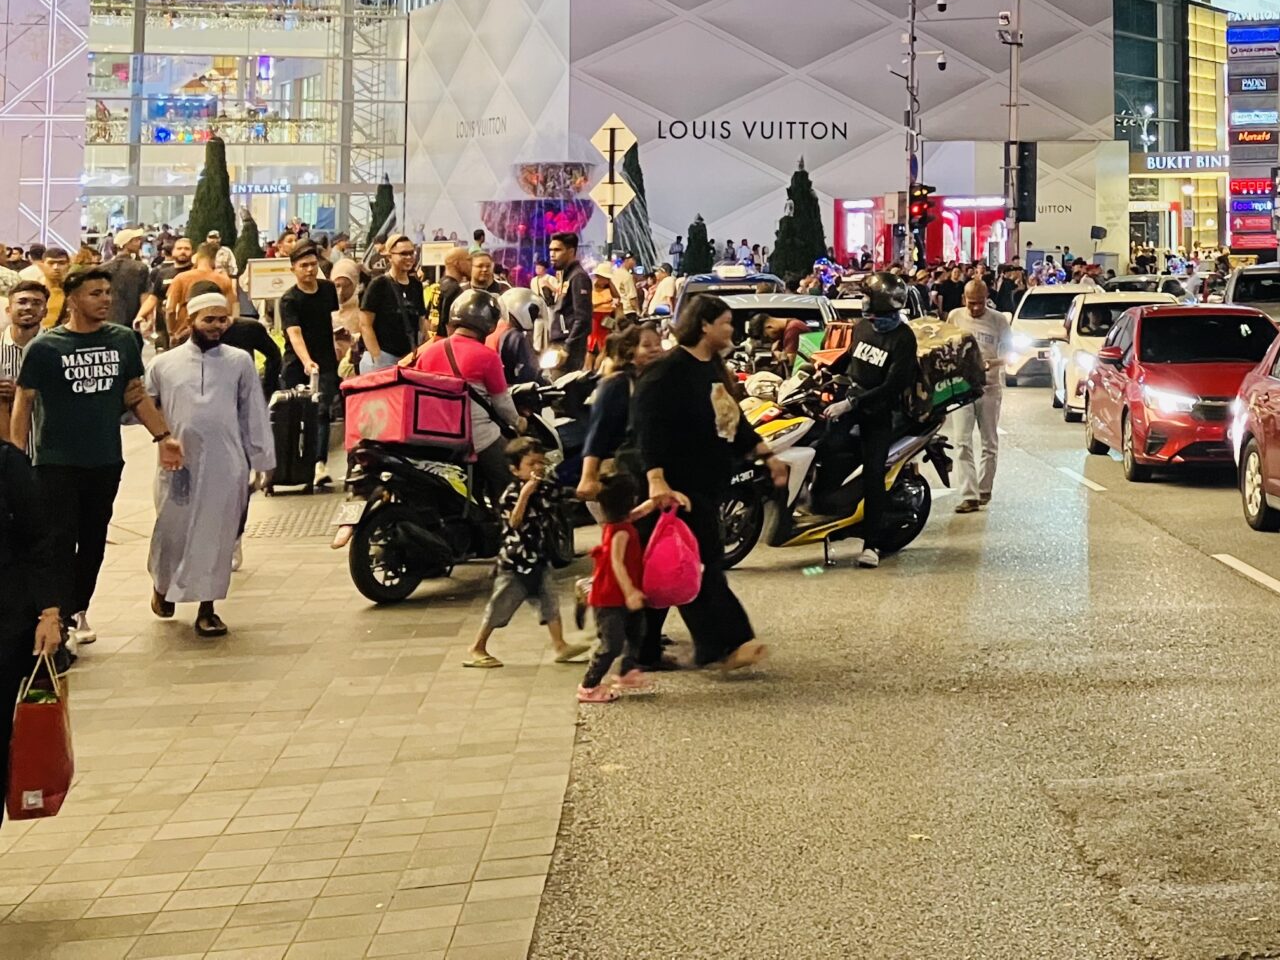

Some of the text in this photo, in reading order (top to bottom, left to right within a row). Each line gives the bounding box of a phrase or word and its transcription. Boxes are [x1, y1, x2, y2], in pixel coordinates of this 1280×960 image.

[658, 120, 847, 140] LOUIS VUITTON
[1147, 155, 1193, 170] BUKIT
[1196, 154, 1230, 168] BINT
[231, 184, 291, 194] ENTRANCE
[1038, 204, 1072, 214] UITTON
[61, 350, 120, 368] MASTER
[853, 341, 889, 367] KUSH
[64, 363, 119, 381] COURSE
